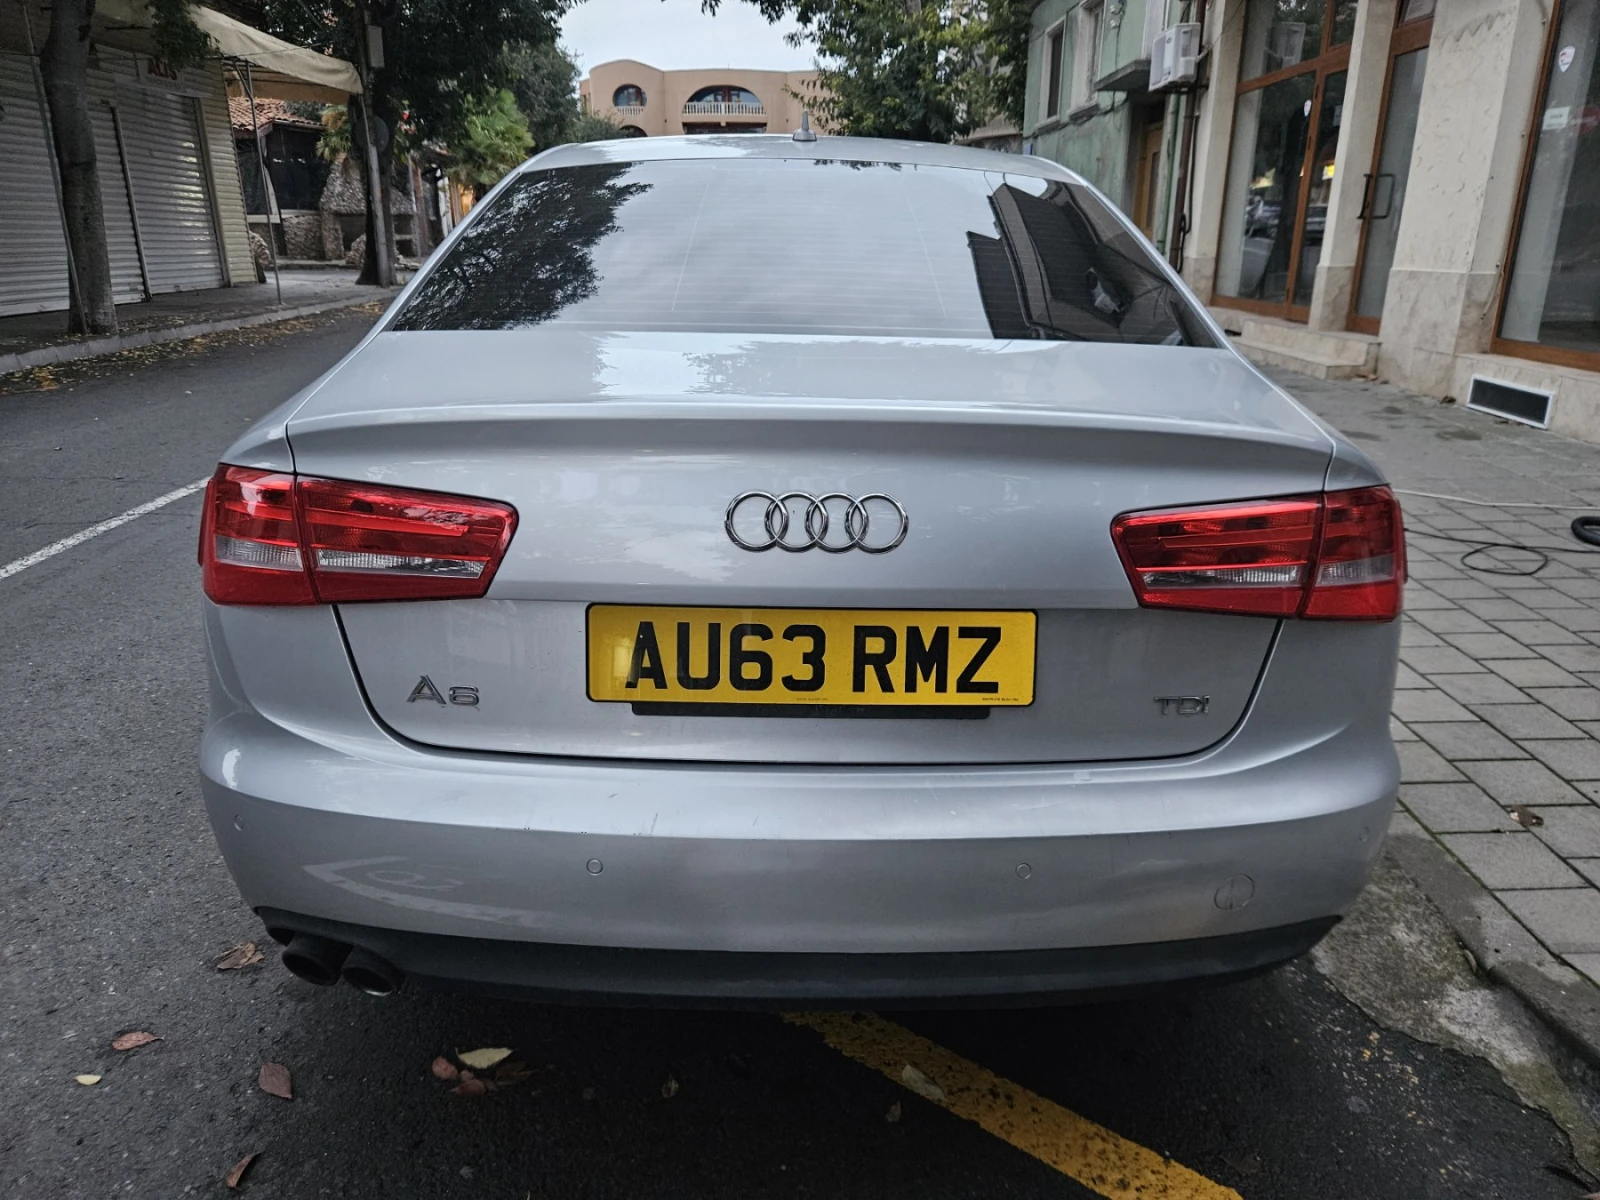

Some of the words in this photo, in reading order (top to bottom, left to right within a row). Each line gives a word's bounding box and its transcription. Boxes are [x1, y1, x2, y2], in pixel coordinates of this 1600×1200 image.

[625, 621, 826, 692] AU63
[852, 625, 1002, 694] RMZ
[406, 674, 480, 706] A6
